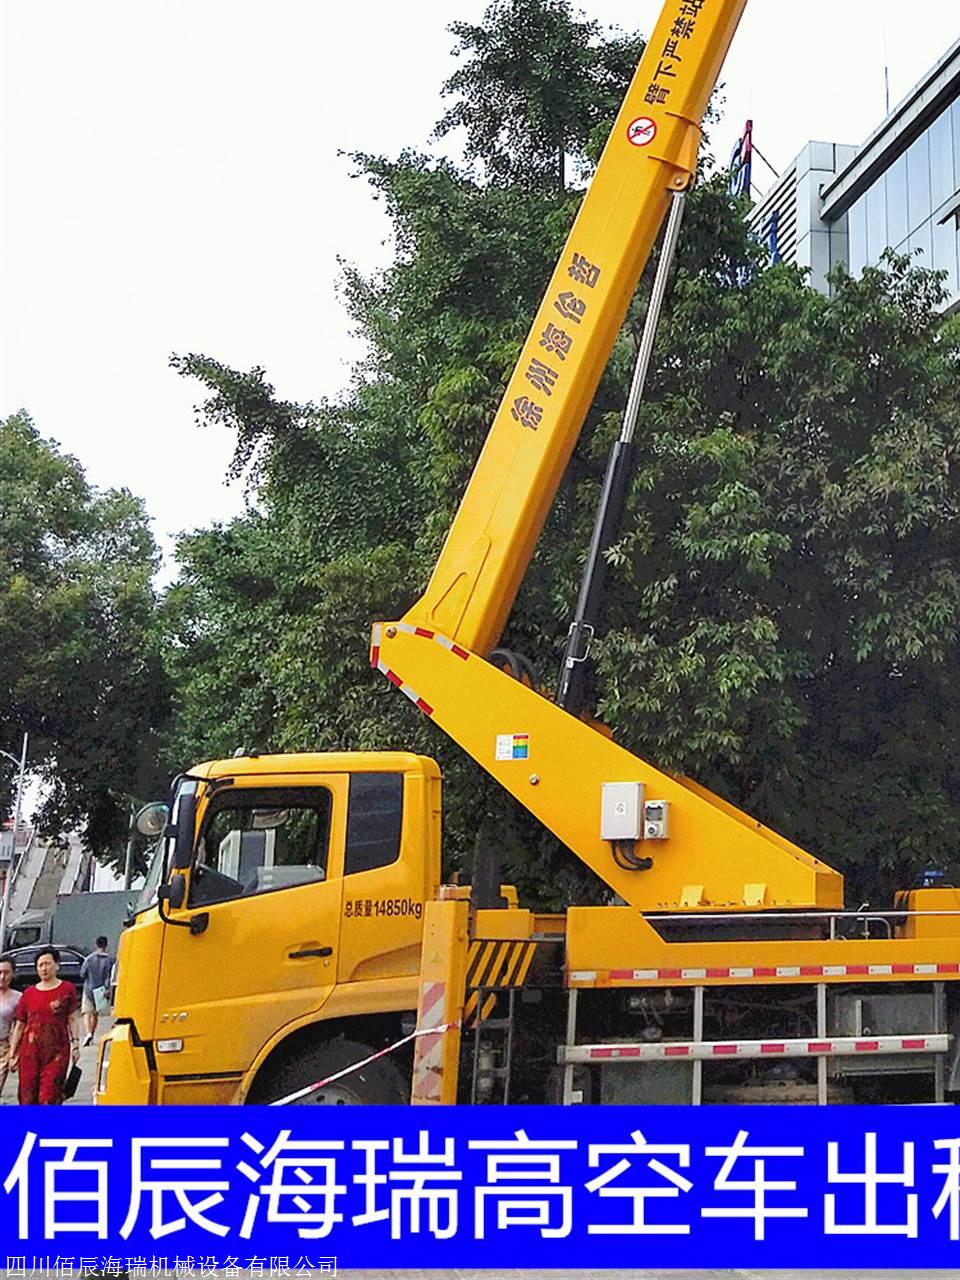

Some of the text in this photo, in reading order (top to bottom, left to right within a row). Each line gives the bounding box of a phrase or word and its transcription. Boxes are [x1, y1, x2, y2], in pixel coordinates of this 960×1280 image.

[510, 251, 602, 431] 徐州海伦哲
[344, 898, 422, 919] 总质量14850kg
